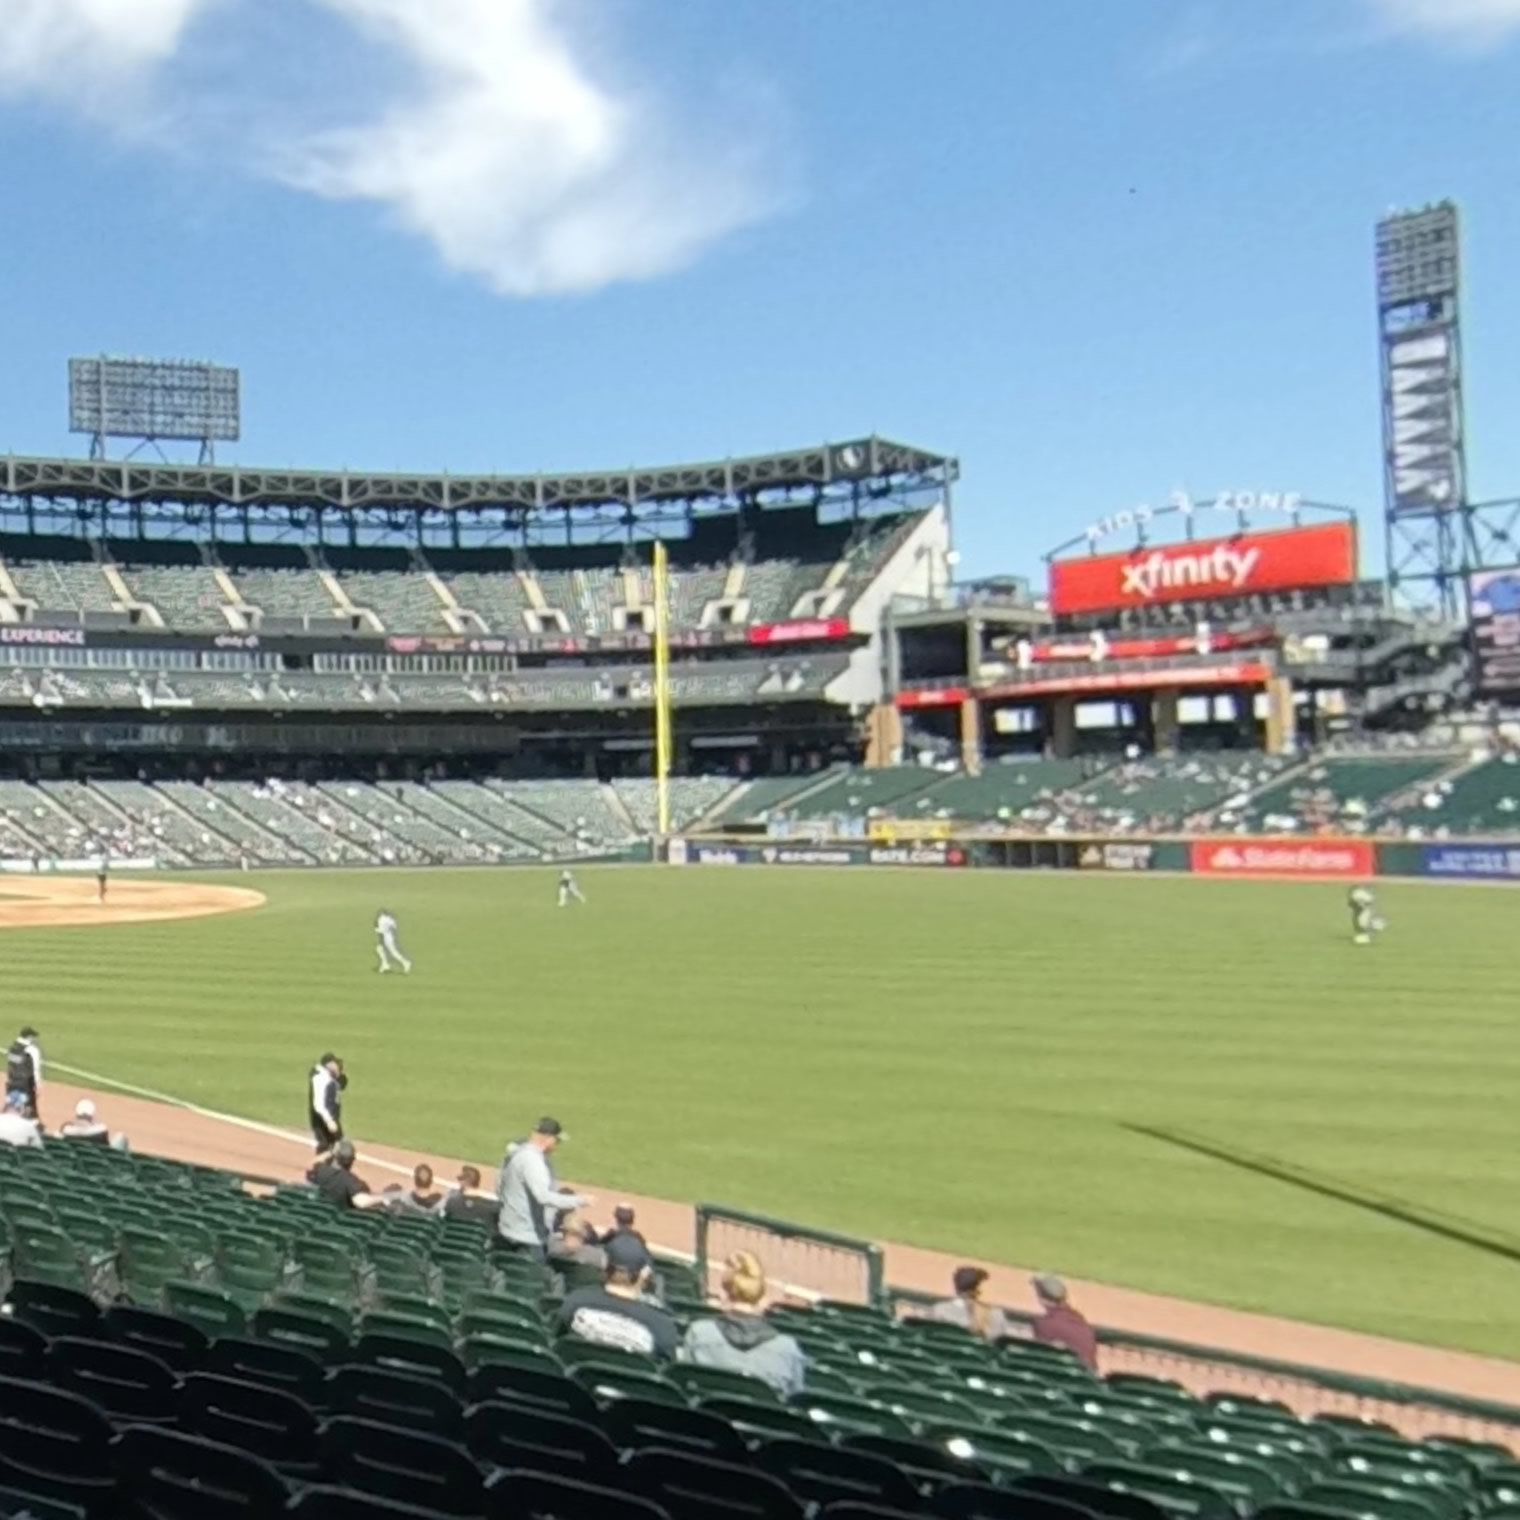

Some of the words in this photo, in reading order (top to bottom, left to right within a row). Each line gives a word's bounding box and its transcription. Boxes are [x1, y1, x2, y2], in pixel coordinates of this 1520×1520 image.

[1085, 503, 1154, 541] KIDS
[1212, 491, 1301, 513] ZONE
[1121, 545, 1261, 597] xfinity
[1, 627, 86, 646] EXPERIENCE
